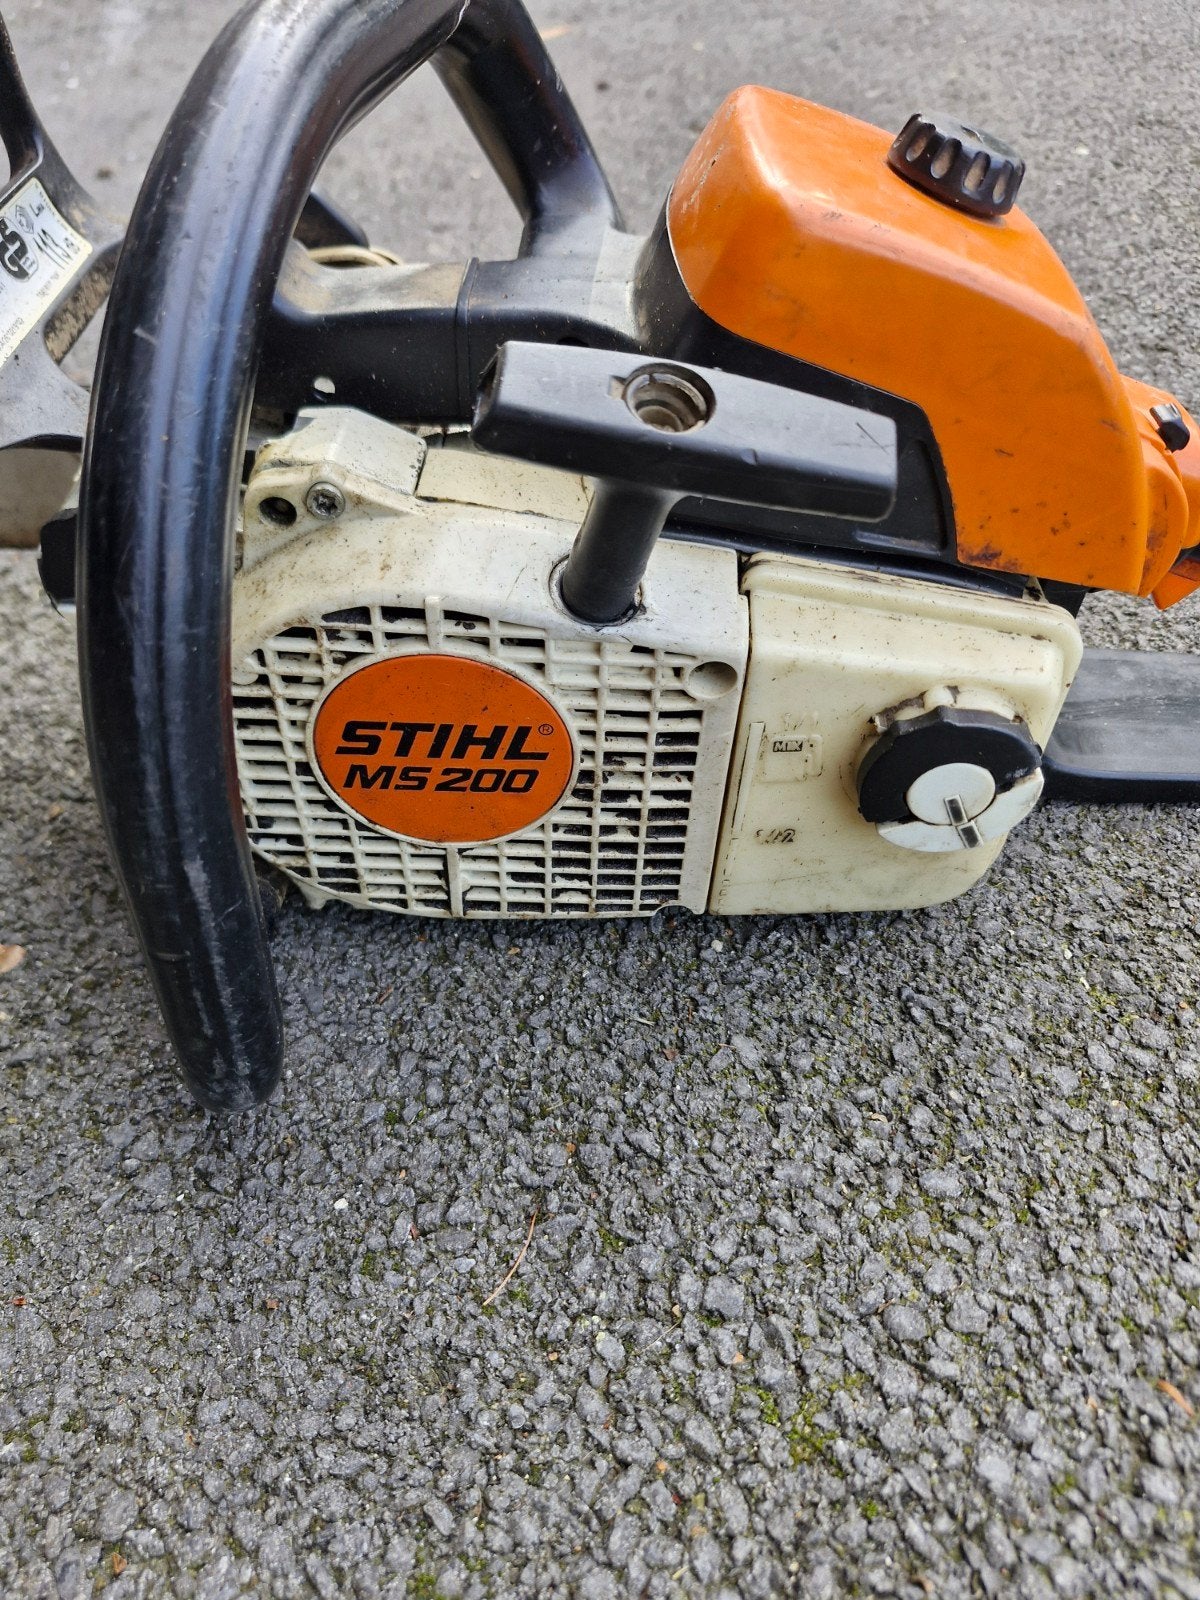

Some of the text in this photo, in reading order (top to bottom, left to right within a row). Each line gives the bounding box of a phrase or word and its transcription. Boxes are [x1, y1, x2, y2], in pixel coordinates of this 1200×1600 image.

[335, 720, 550, 761] STIHL
[343, 764, 540, 793] MS 200
